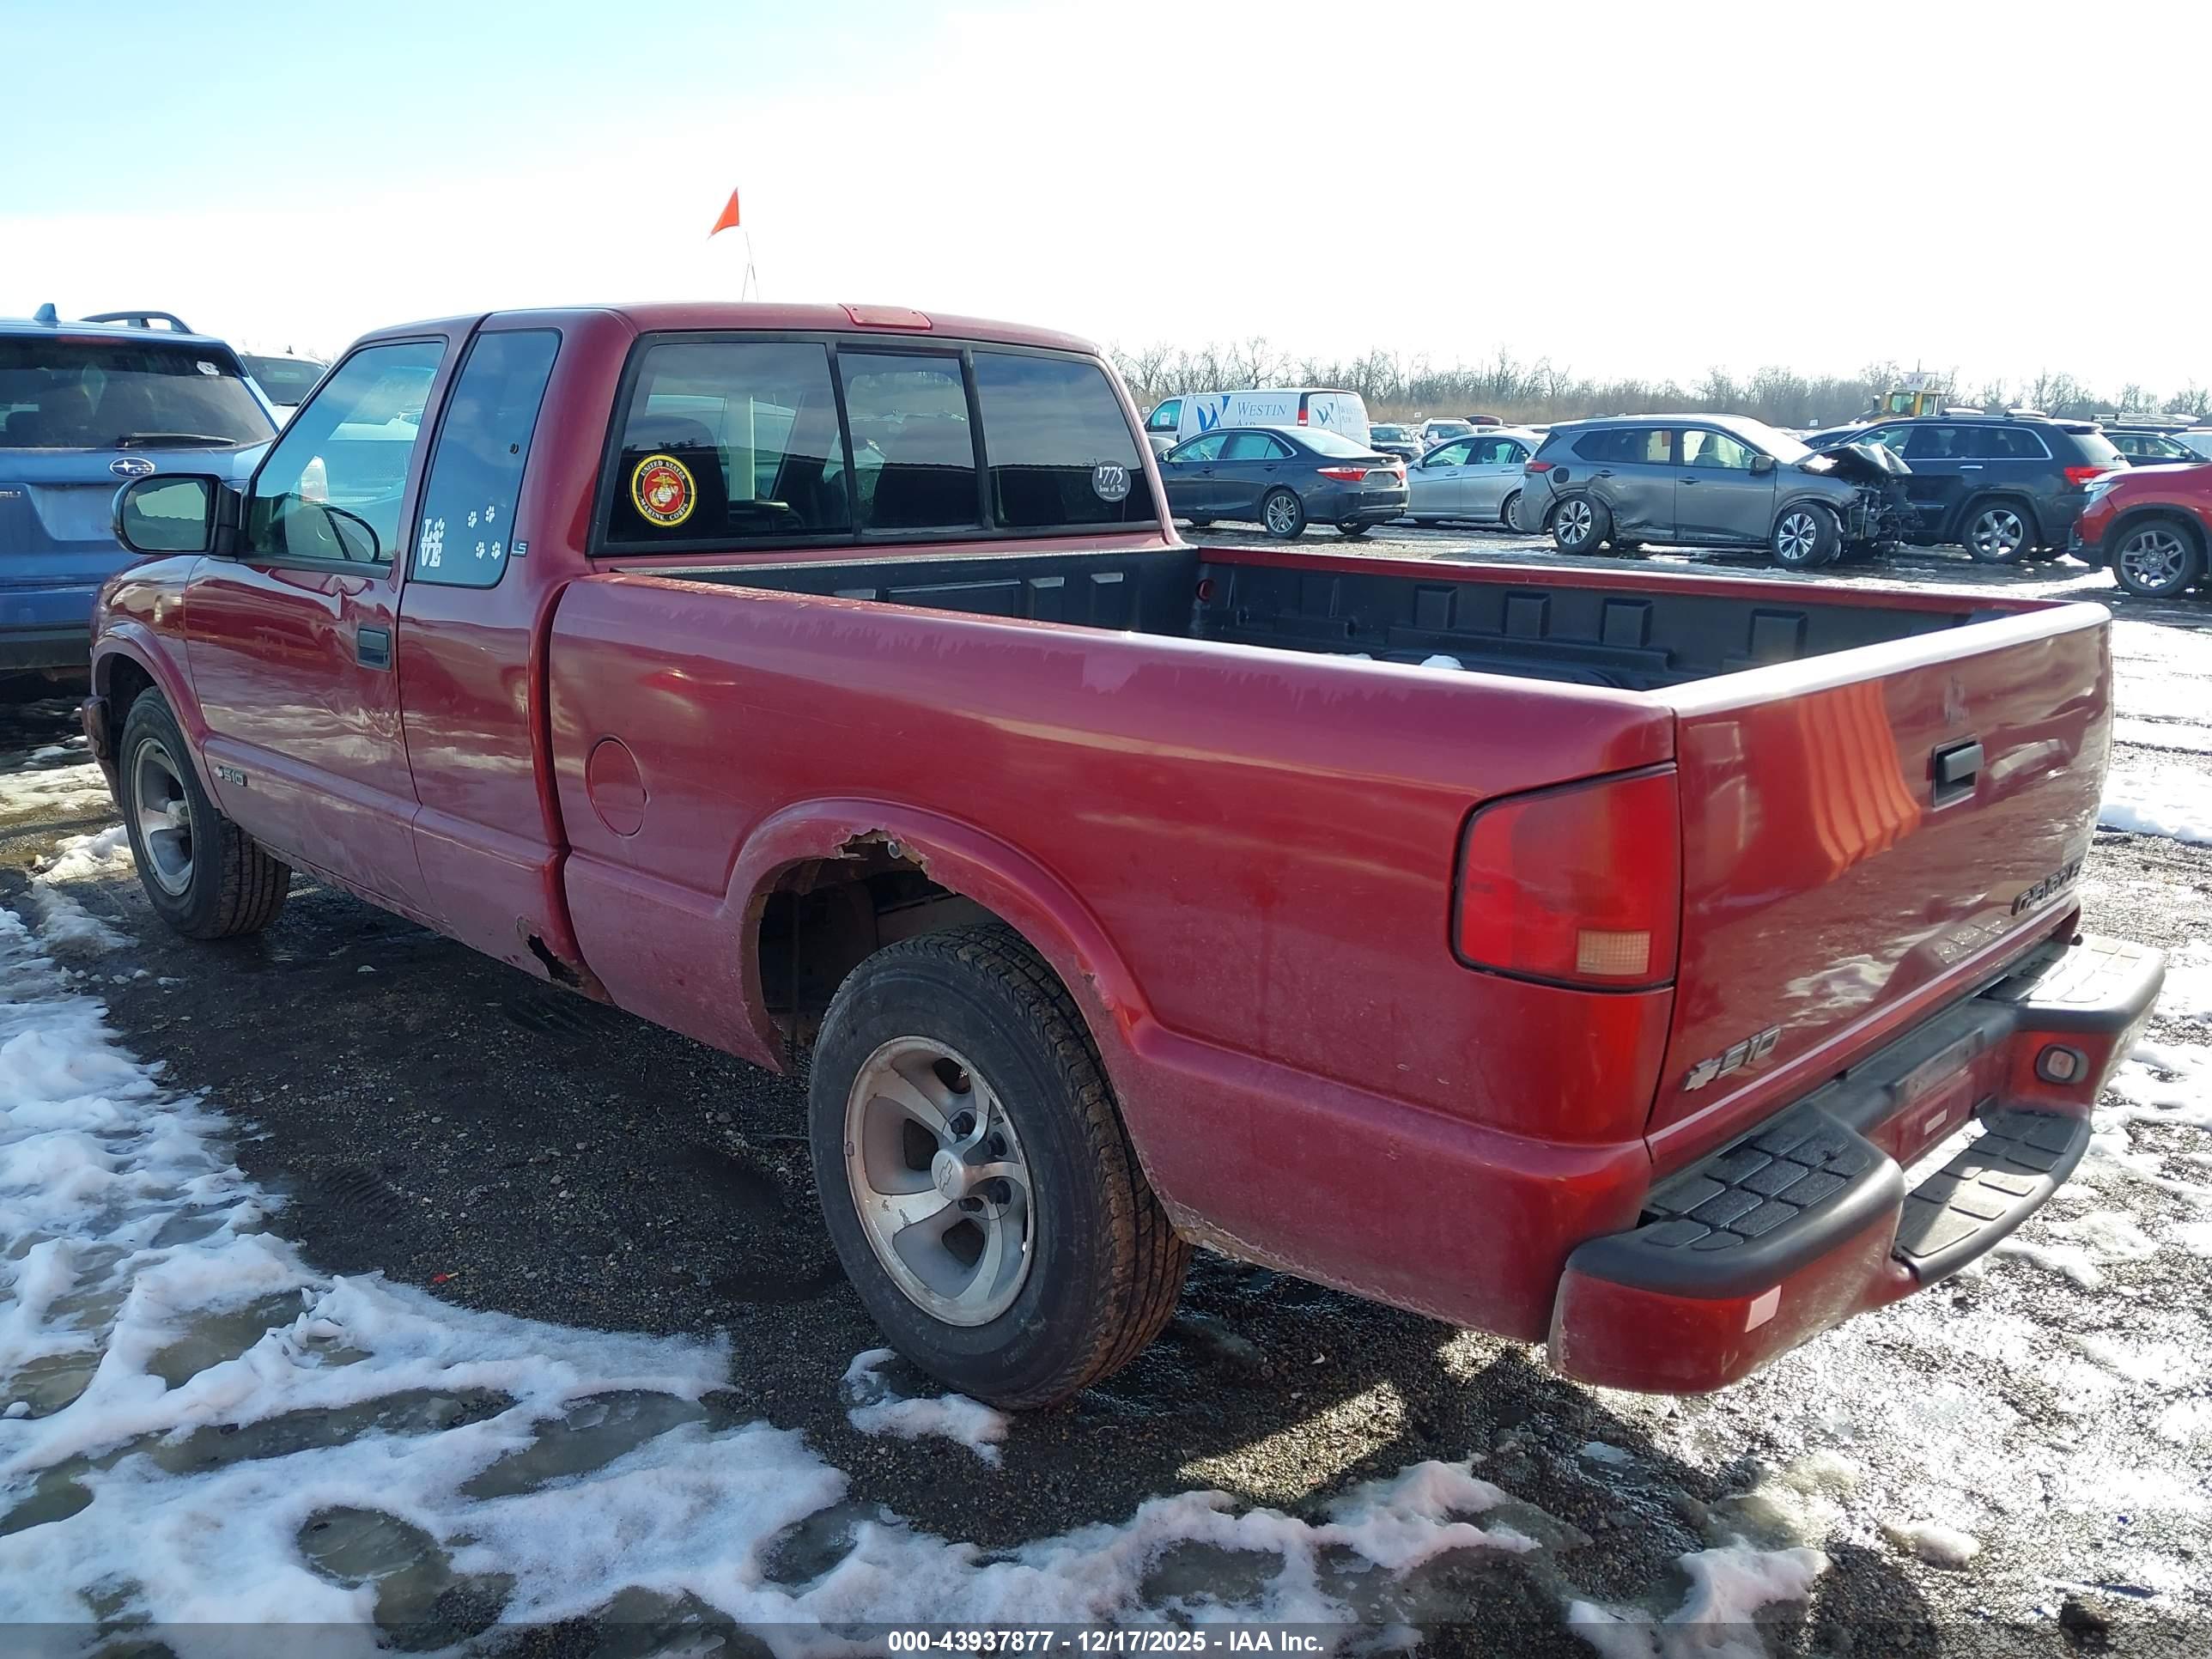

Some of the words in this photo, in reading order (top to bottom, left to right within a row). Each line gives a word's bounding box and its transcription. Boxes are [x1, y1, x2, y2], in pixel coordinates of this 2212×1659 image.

[1237, 402, 1287, 416] WESTIN
[640, 459, 664, 477] UNITED
[665, 460, 687, 481] STATES
[1097, 465, 1124, 485] 1775
[638, 495, 665, 521] MARINE
[668, 501, 689, 520] CORPS
[512, 542, 528, 556] LS
[1717, 1024, 1781, 1079] S10
